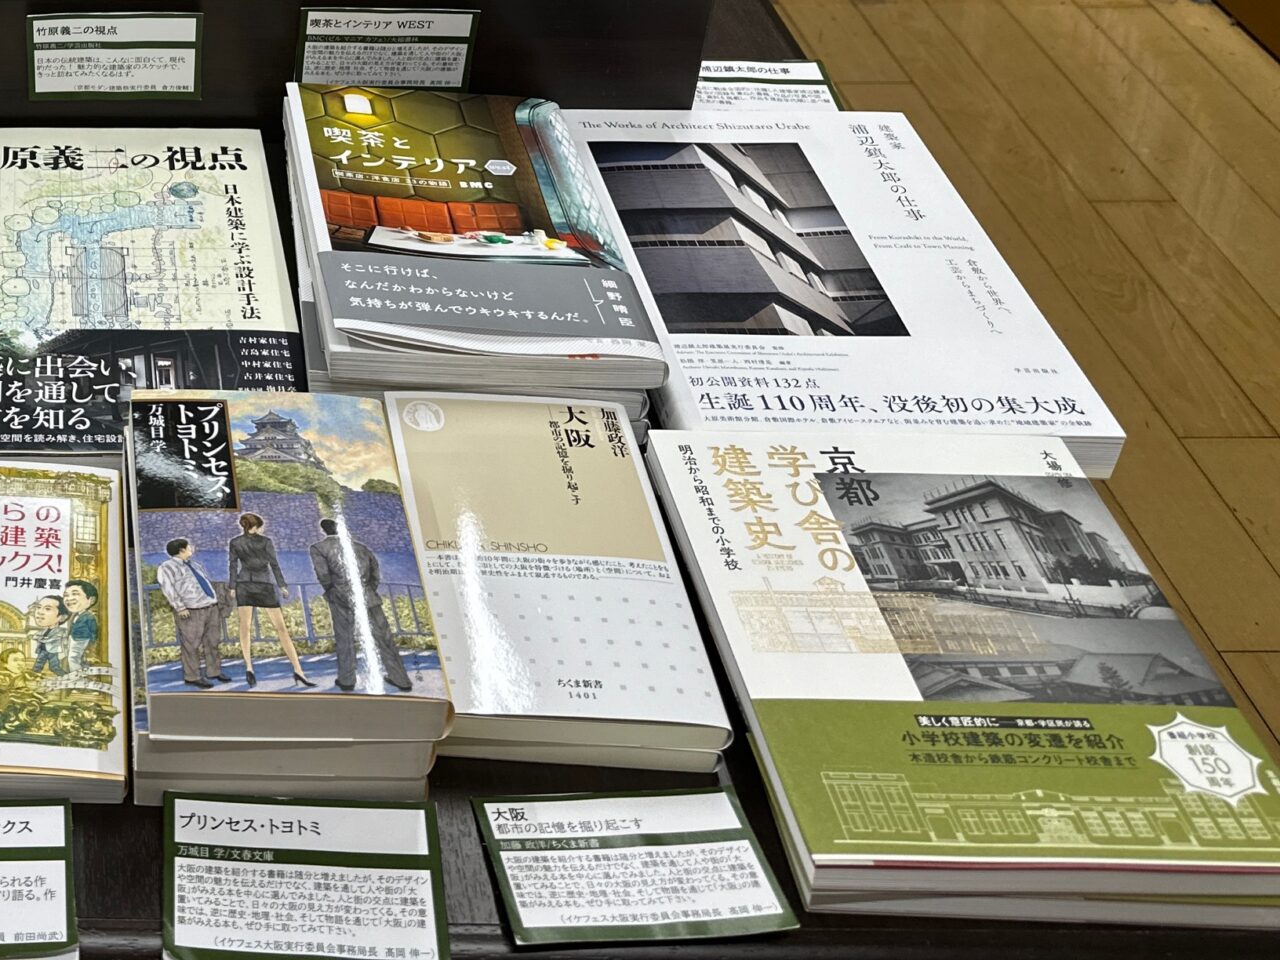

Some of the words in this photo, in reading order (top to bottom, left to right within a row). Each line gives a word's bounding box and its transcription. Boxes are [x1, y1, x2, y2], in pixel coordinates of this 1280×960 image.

[36, 25, 118, 37] 竹原義二の視点
[309, 19, 393, 30] 喫茶とインテリア
[397, 20, 435, 30] WEST
[577, 120, 600, 130] The
[603, 120, 643, 131] Works
[645, 120, 658, 131] of
[660, 120, 713, 132] Architect
[715, 121, 773, 132] Shizutaro
[775, 121, 811, 132] Urabe
[322, 126, 412, 150] 喫茶と
[329, 149, 477, 175] インテリア
[459, 180, 494, 189] BMC
[223, 184, 261, 320] 日本建築に学ぶ設計手法
[344, 279, 516, 302] なんだかわからないけど
[601, 278, 636, 329] 細野晴臣
[688, 375, 820, 390] 初公開資料132点
[558, 405, 596, 450] 大阪
[819, 445, 882, 508] 京都
[707, 444, 798, 552] 建築史
[491, 541, 549, 553] SHINSHO
[5, 576, 63, 591] 門井慶喜
[556, 677, 604, 690] ちくま新書
[568, 691, 599, 700] 1401
[901, 730, 1126, 751] 小学校建築の変遷を紹介
[1189, 757, 1232, 776] 150
[491, 806, 528, 822] 大阪
[178, 811, 322, 836] プリンセス・トヨトミ
[496, 817, 643, 834] 都市の記憶を掘り起こす
